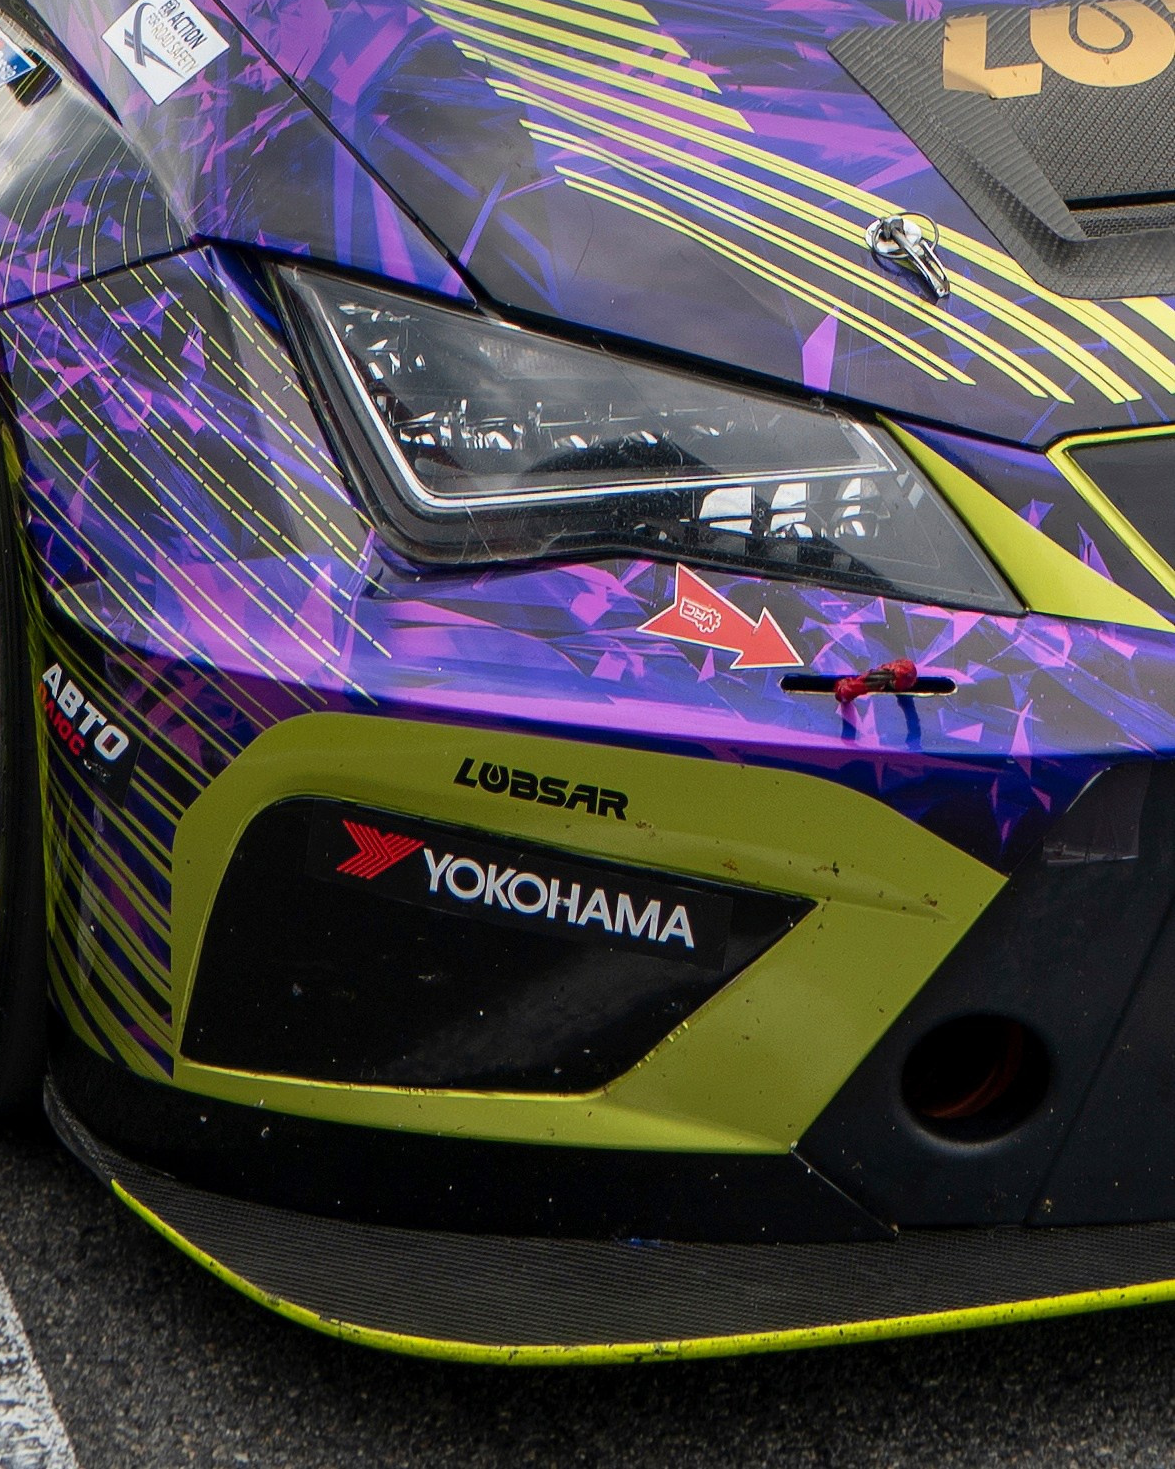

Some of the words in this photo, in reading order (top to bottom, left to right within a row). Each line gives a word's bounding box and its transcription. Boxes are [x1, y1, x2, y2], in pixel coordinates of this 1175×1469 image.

[150, 21, 176, 48] ROAD
[166, 40, 199, 75] SAFETY
[166, 8, 208, 51] ACTION
[42, 662, 130, 761] АВТО
[453, 757, 629, 821] LUBSAR
[423, 846, 695, 949] YOKOHAMA
